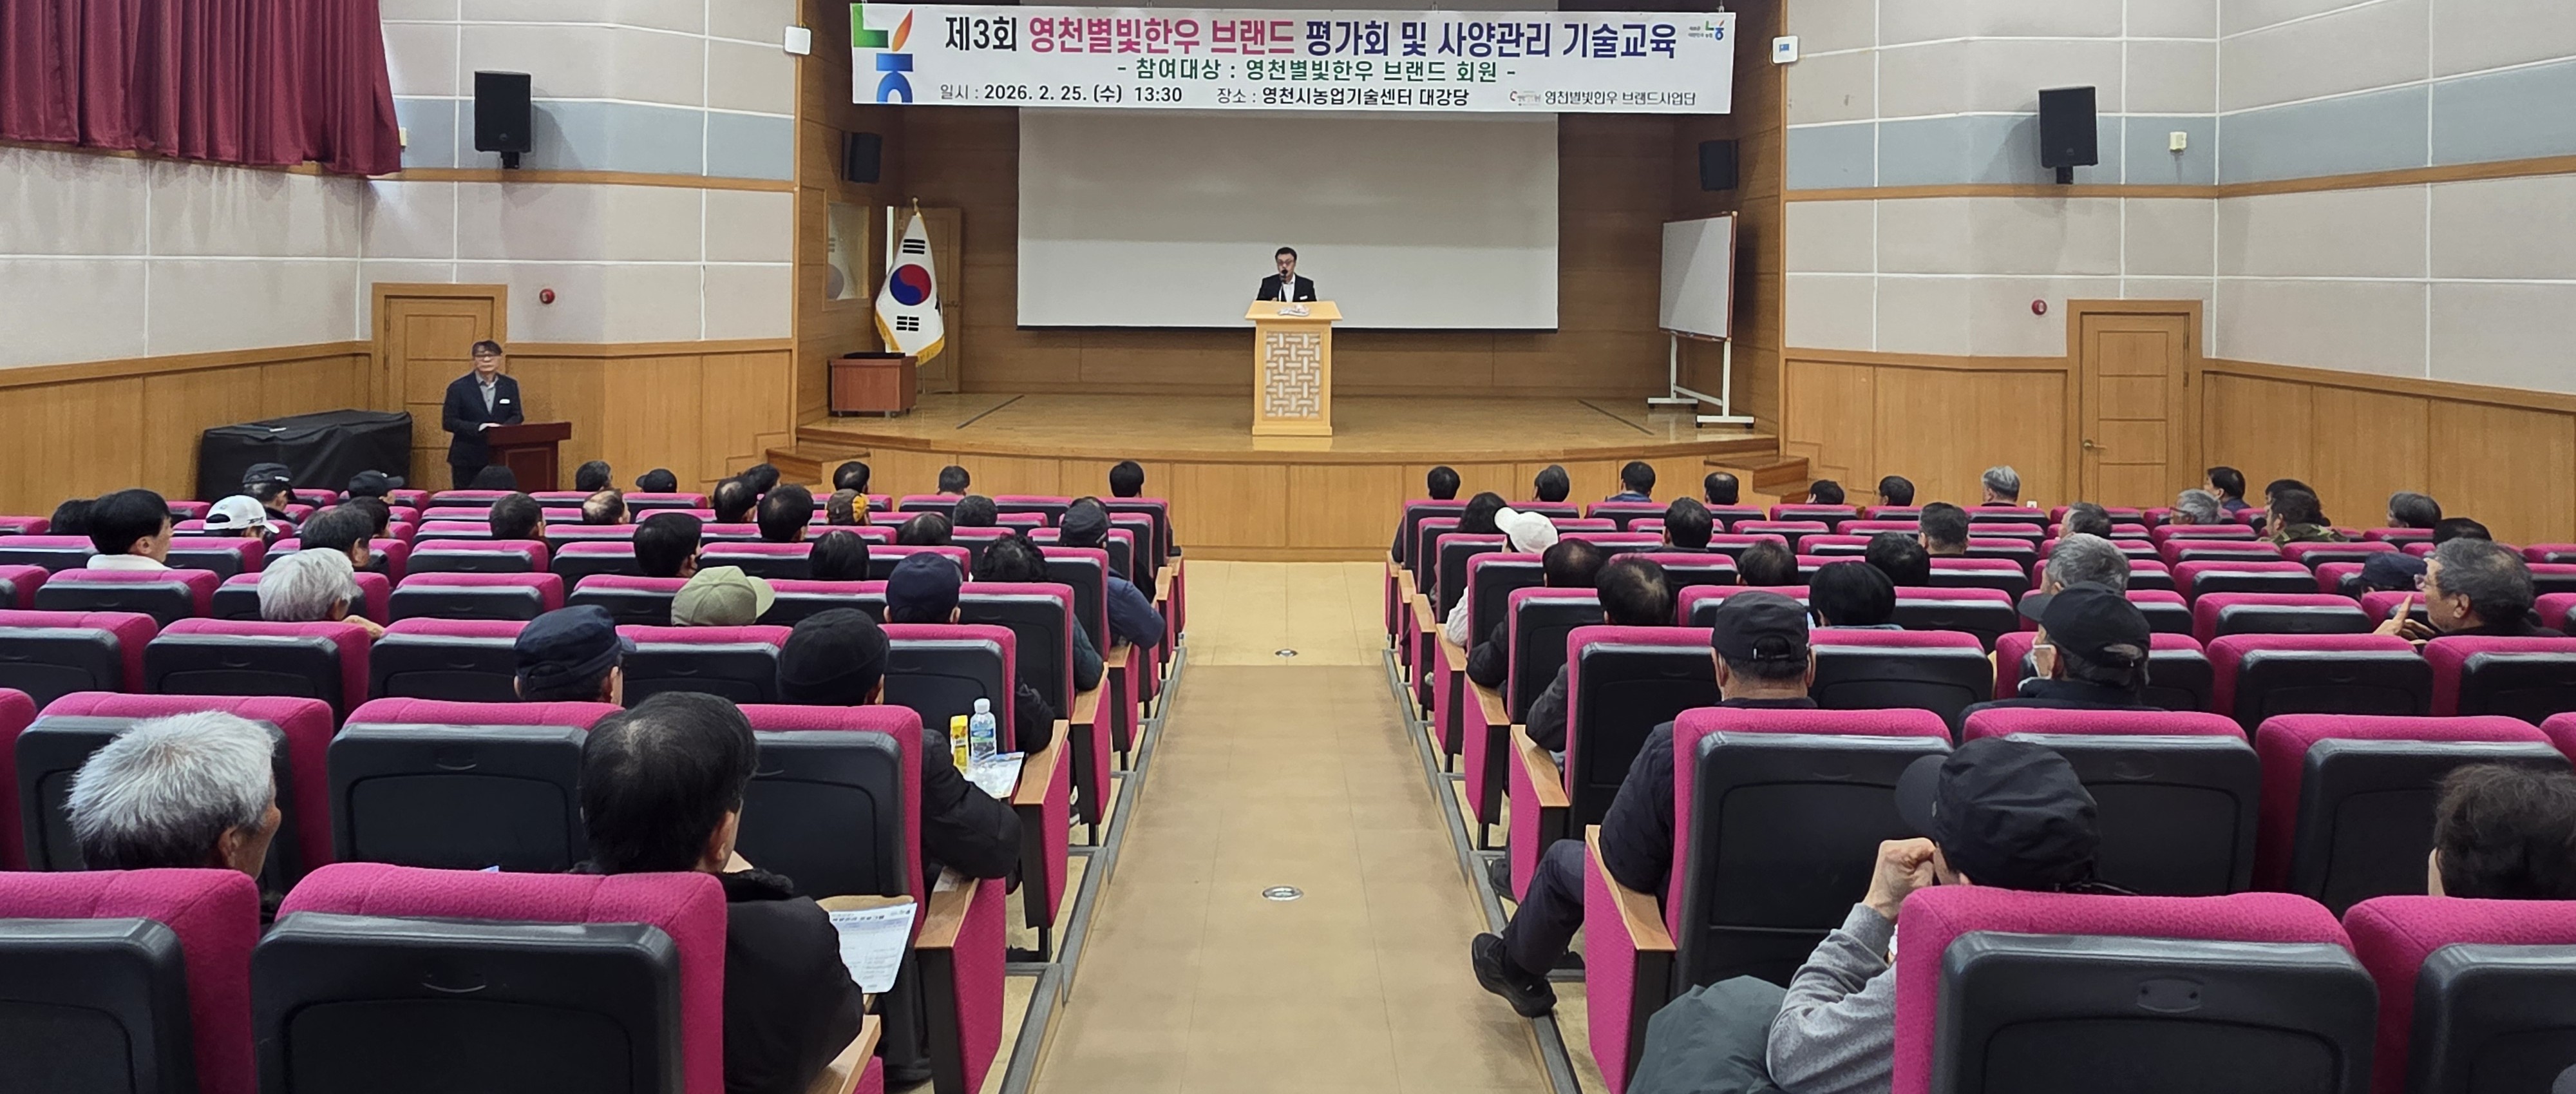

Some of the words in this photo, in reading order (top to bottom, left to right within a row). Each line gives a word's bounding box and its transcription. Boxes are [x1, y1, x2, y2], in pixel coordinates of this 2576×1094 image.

[945, 16, 1016, 52] 제3회
[1030, 17, 1200, 55] 영천별빛한우
[1211, 19, 1294, 55] 브랜드
[1306, 21, 1389, 57] 평가회
[1402, 22, 1426, 57] 및
[1438, 23, 1551, 58] 사양관리
[1563, 23, 1676, 59] 기술교육
[1137, 58, 1221, 79] 참여대상
[1247, 59, 1373, 81] 영천별빛한우
[1384, 61, 1445, 82] 브랜드
[1457, 61, 1496, 82] 회원
[940, 85, 969, 100] 일시
[985, 84, 1032, 100] 2026.
[1039, 86, 1054, 100] 2.
[1061, 86, 1086, 101] 25.
[1094, 84, 1122, 103] (수)
[1135, 86, 1182, 102] 13:30
[1218, 88, 1246, 103] 장소
[1263, 87, 1412, 106] 영천시농업기술센터
[1419, 89, 1469, 106] 대강당
